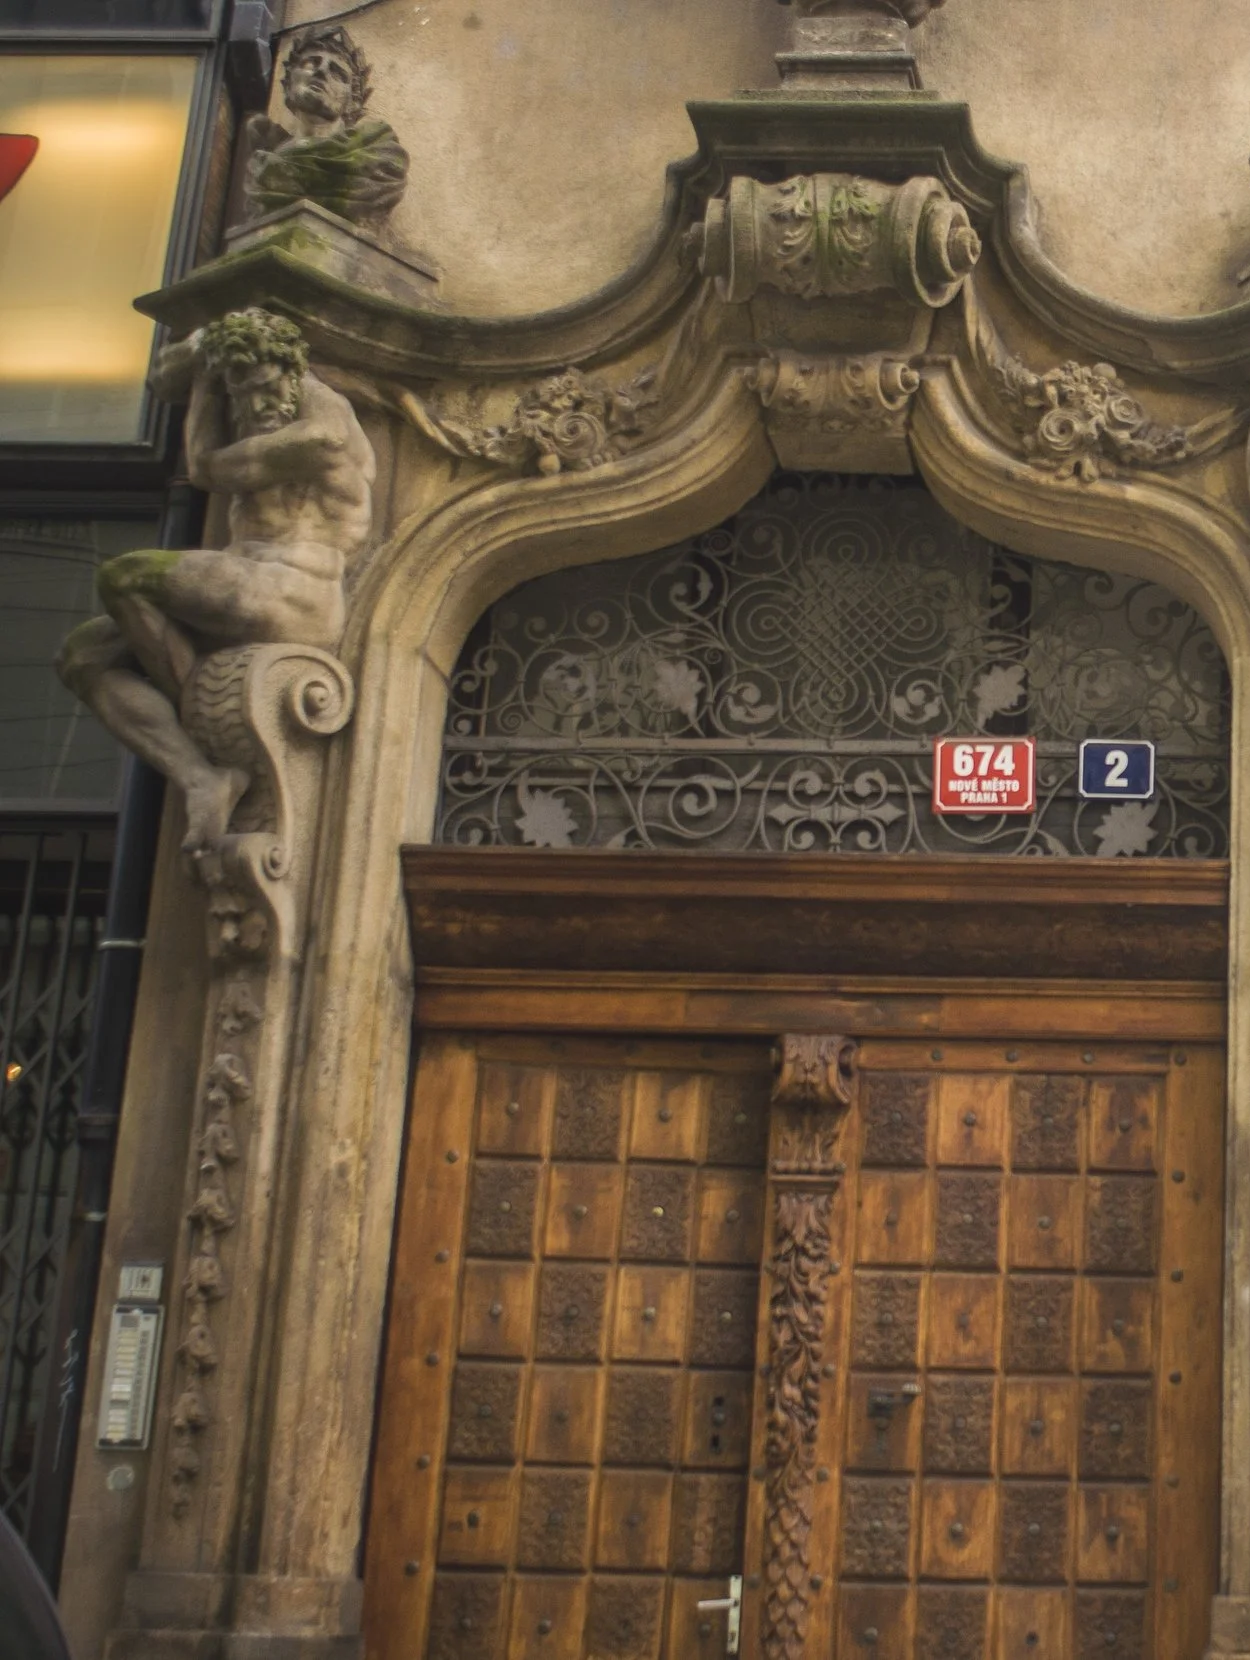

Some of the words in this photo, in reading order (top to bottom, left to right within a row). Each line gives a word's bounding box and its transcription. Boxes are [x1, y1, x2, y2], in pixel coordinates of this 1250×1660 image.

[953, 744, 1016, 777] 674
[1105, 749, 1129, 787] 2
[948, 777, 978, 792] NOVÉ
[981, 777, 1020, 792] MĚSTO
[960, 791, 999, 804] PRAHA
[1001, 791, 1008, 804] 1
